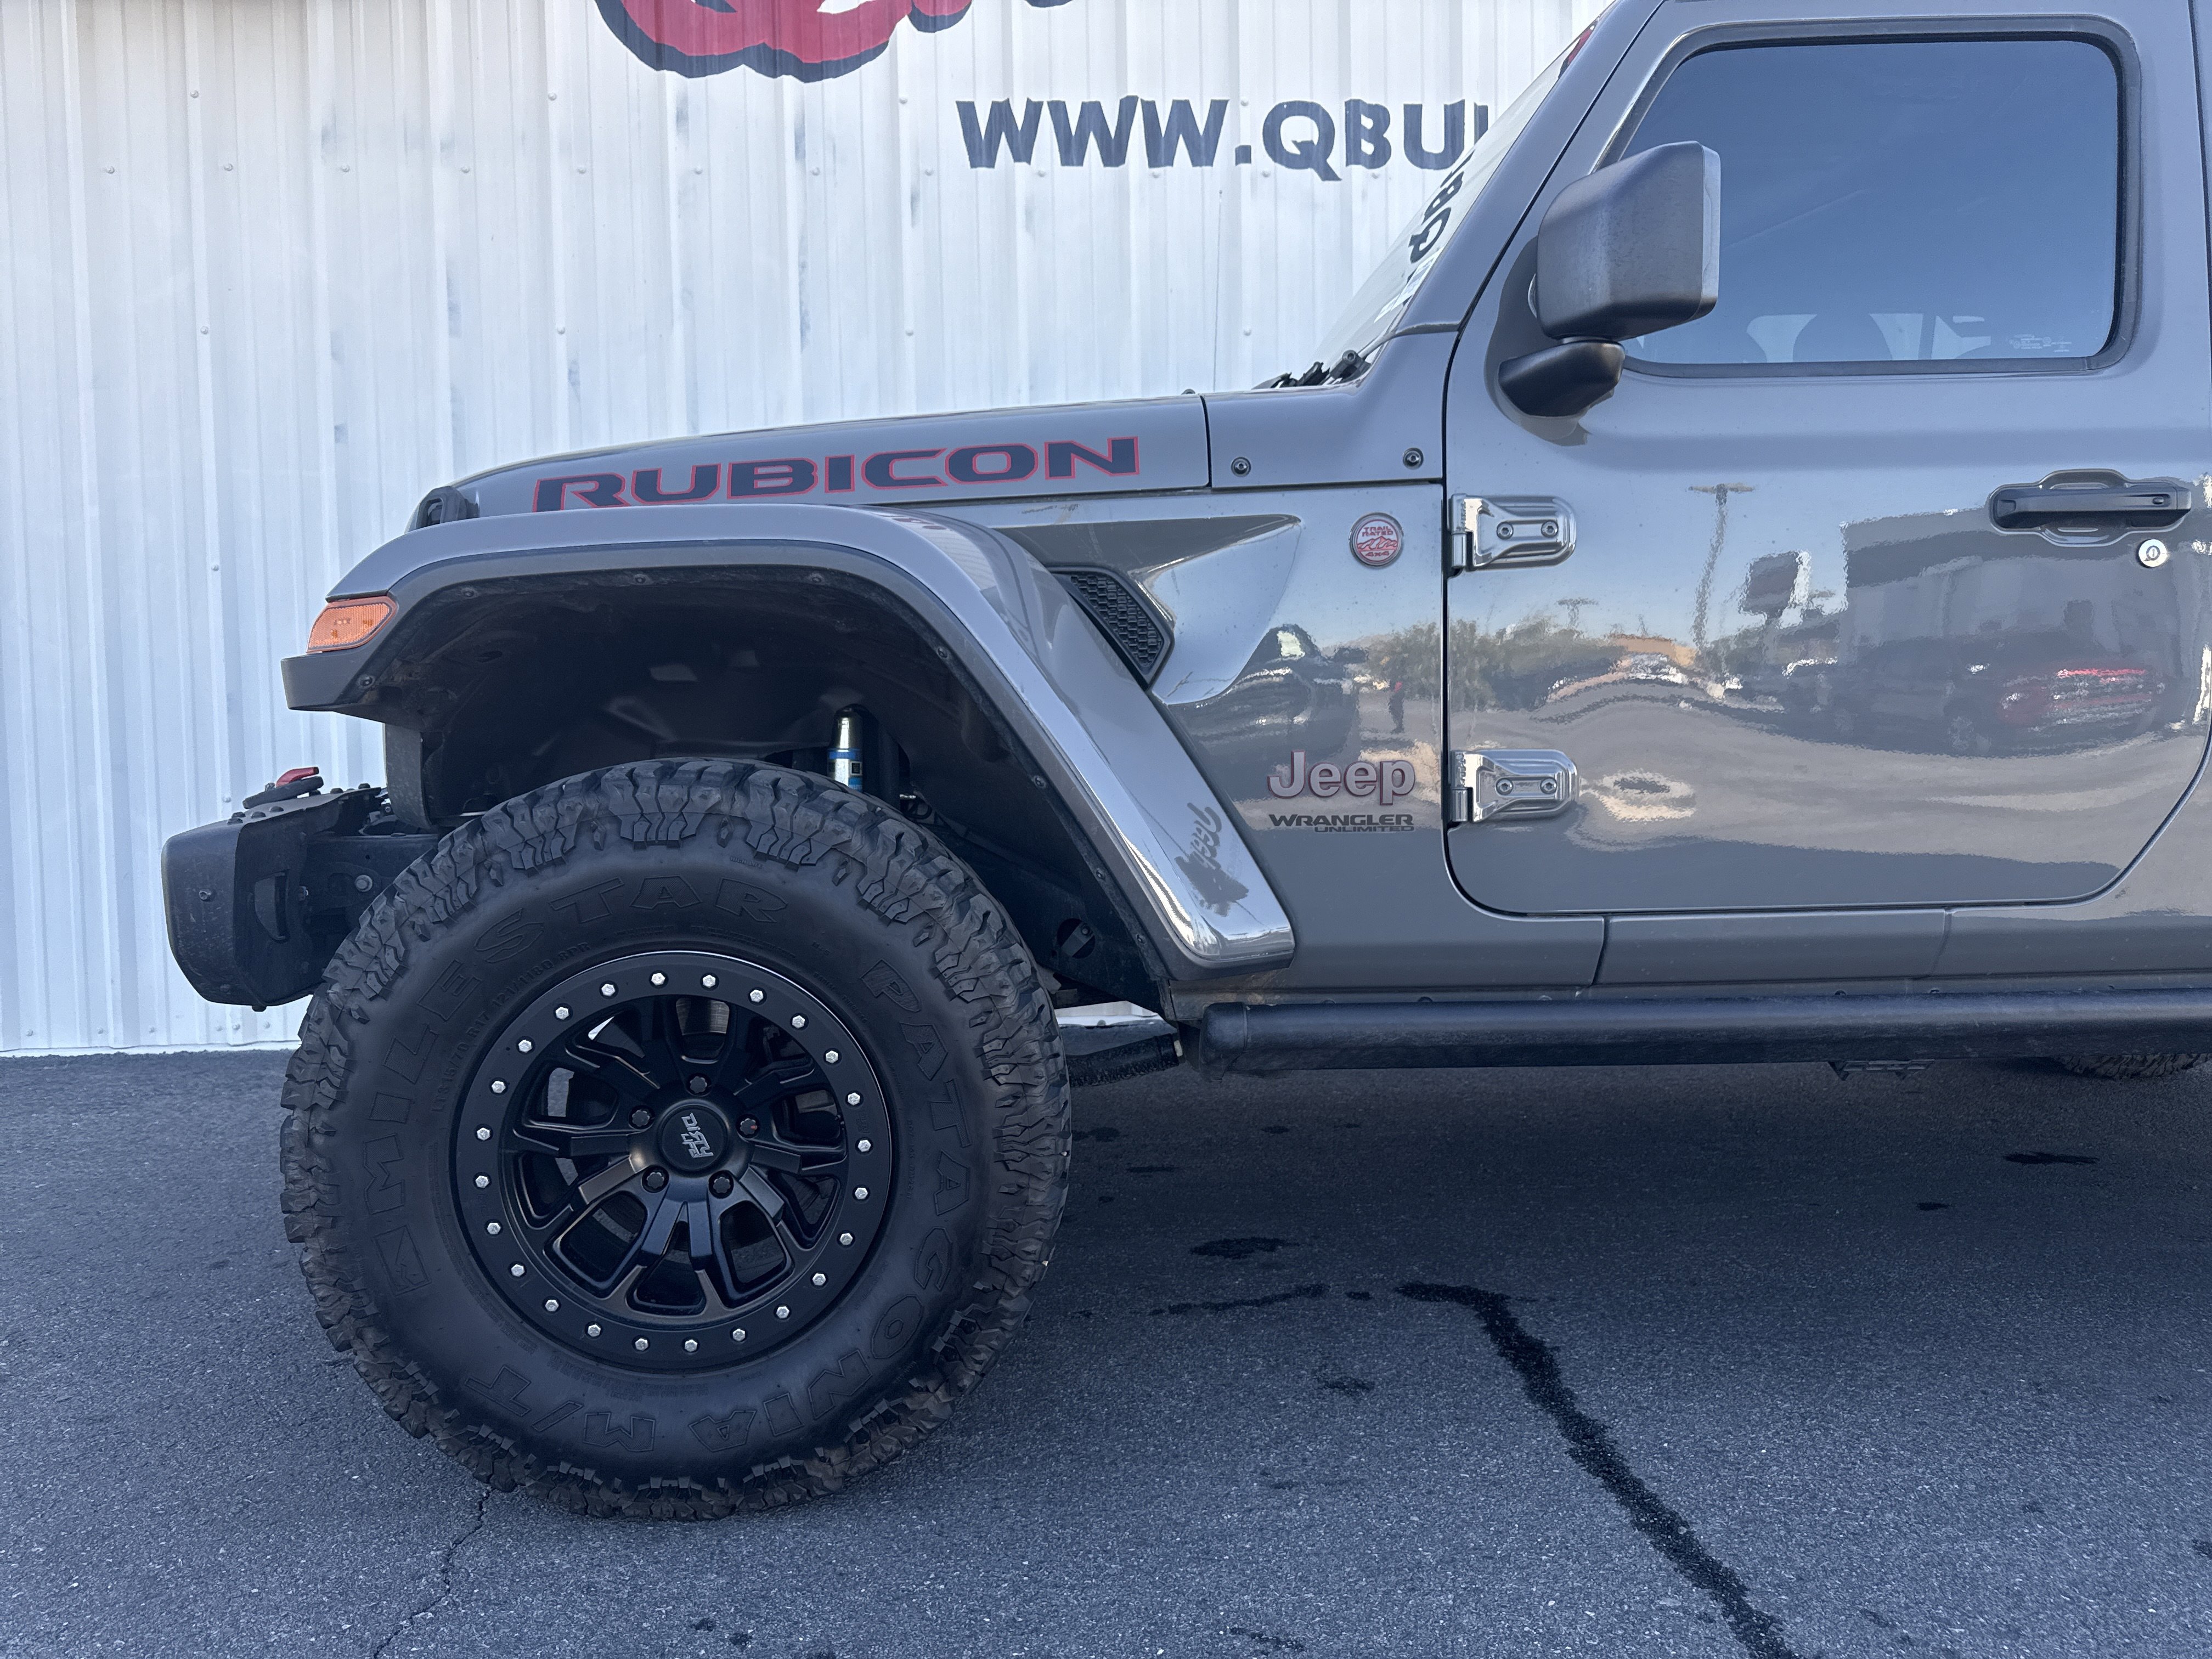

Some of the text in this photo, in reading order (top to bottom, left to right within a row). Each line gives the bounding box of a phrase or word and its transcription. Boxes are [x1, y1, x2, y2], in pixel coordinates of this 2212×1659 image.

[533, 436, 1139, 514] RUBICON
[1267, 749, 1416, 805] Jeep
[1268, 814, 1413, 826] WRANGLER
[466, 1011, 490, 1039] R17
[557, 941, 591, 961] 8PR
[362, 876, 788, 1215] MILESTAR
[681, 1112, 714, 1158] DIRTY
[688, 958, 972, 1452] PATAGONIA
[464, 1364, 654, 1450] M/T
